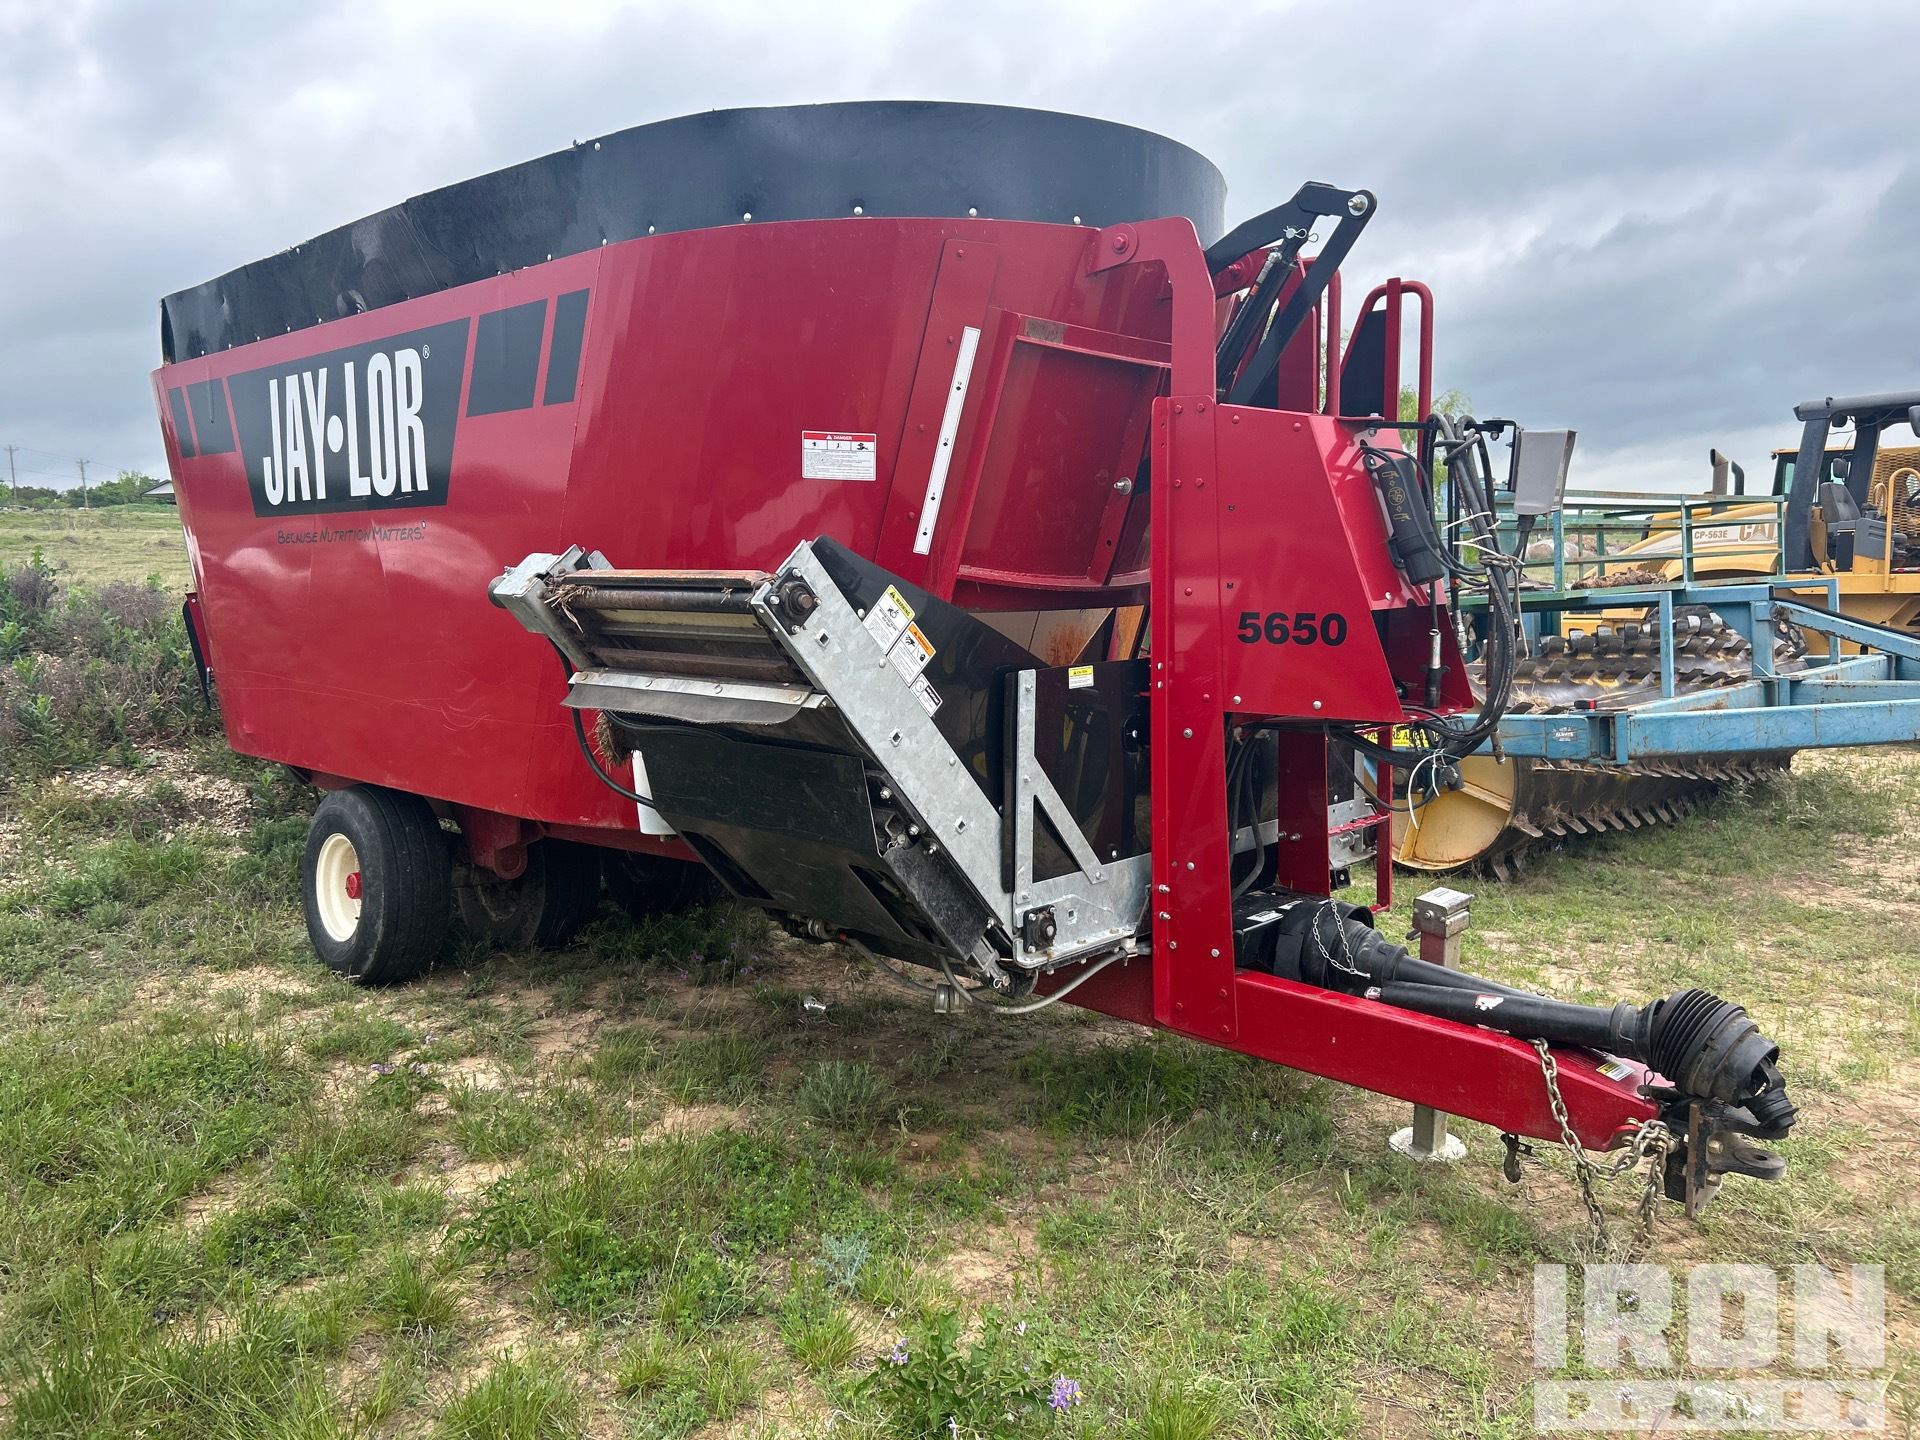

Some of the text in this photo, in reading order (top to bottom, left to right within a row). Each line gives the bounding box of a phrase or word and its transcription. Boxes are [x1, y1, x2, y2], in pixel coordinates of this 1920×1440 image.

[1694, 529, 1728, 540] CP-563E
[895, 597, 911, 617] WARNING
[1237, 611, 1347, 647] 5650
